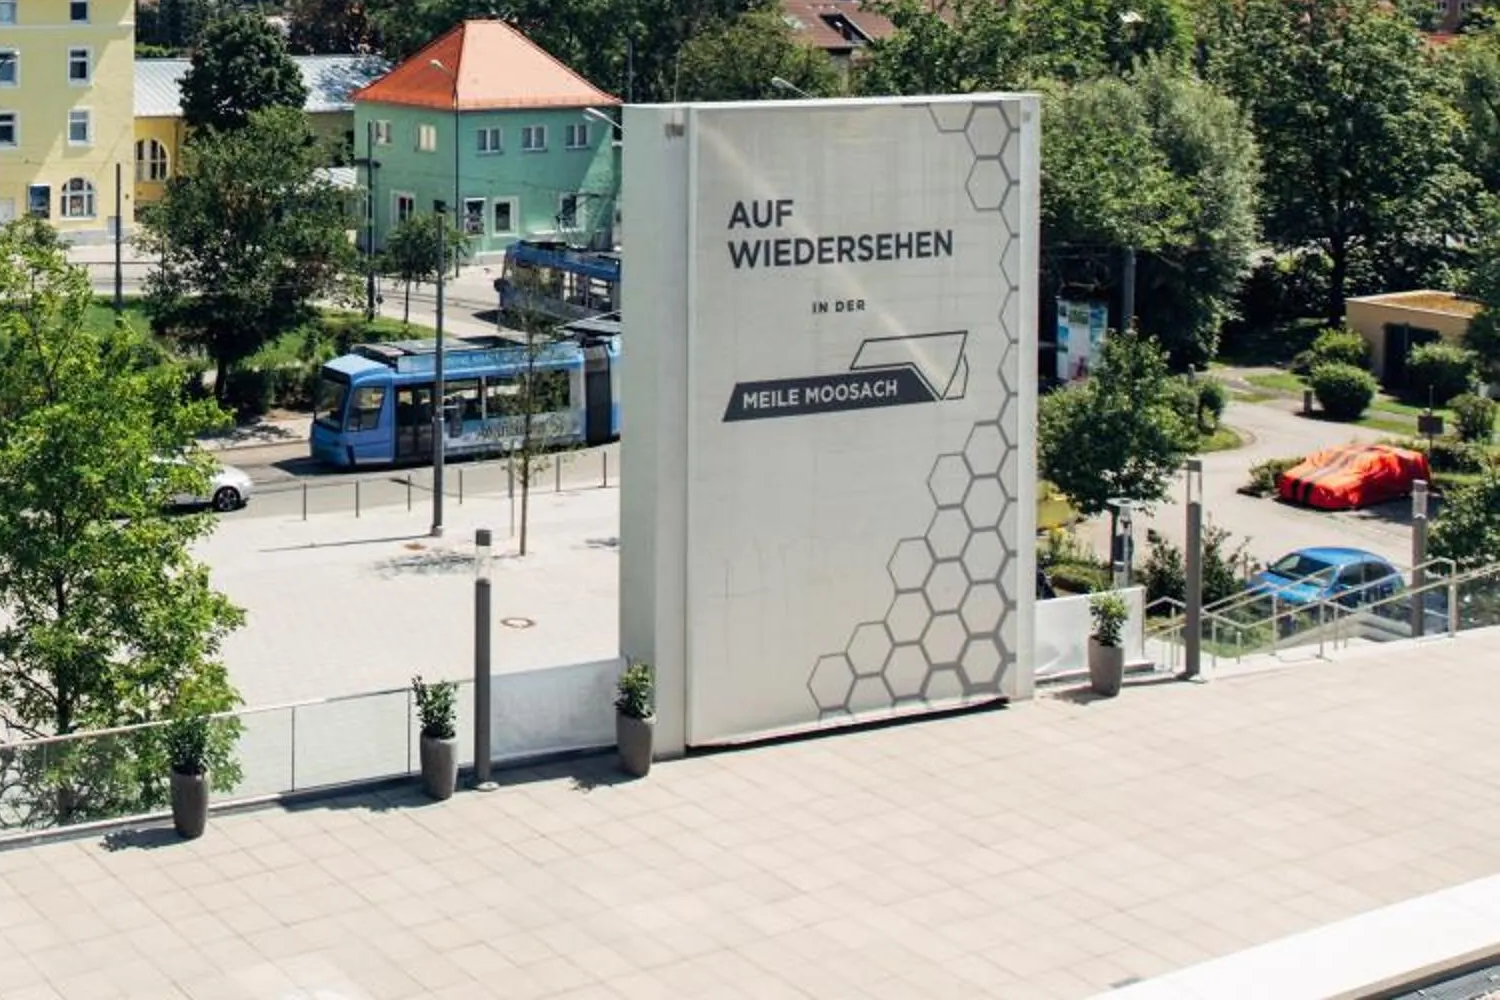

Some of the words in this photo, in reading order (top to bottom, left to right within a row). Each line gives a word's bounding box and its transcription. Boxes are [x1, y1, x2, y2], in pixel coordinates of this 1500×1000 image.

[727, 199, 794, 230] AUF
[727, 229, 953, 269] WIEDERSEHEN
[812, 301, 828, 314] IN
[835, 299, 865, 313] DER
[743, 387, 799, 409] MEILE
[805, 379, 898, 404] MOOSACH
